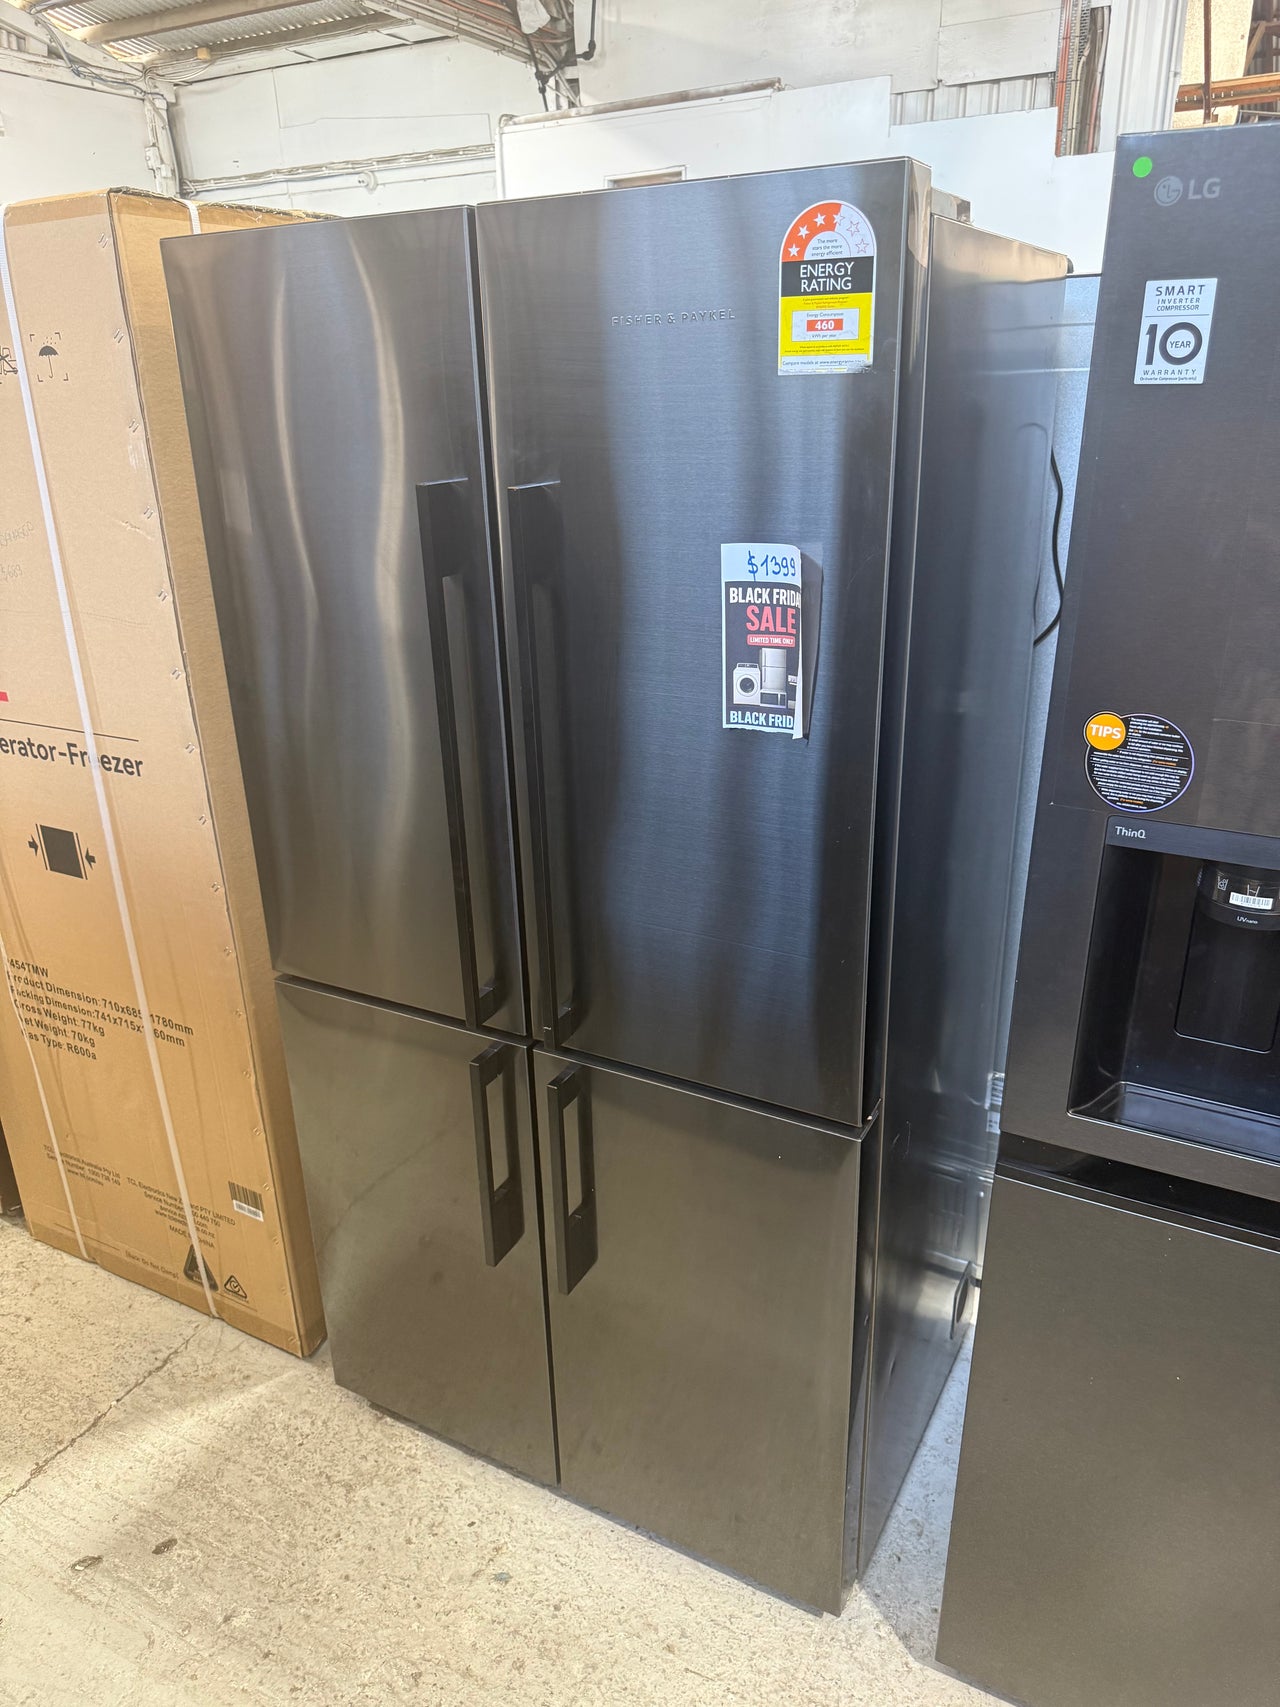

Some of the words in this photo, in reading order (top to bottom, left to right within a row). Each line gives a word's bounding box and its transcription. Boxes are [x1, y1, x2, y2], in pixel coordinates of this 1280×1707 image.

[1188, 177, 1221, 200] LG
[800, 261, 855, 278] ENERGY
[801, 277, 852, 293] RATING
[1155, 284, 1206, 297] SMART
[1156, 304, 1200, 312] COMPRESSOR
[1157, 297, 1201, 305] INVERTER
[611, 314, 662, 326] FISHER
[667, 312, 676, 324] &
[681, 308, 736, 322] PAYKEL
[814, 320, 835, 330] 460
[1145, 321, 1203, 366] 10
[1169, 340, 1192, 349] YEAR
[1143, 368, 1197, 376] WARRANTY
[747, 550, 797, 582] $1399
[729, 586, 771, 605] BLACK
[745, 604, 797, 635] SALE
[749, 636, 770, 644] LIMITED
[770, 637, 782, 645] TIME
[729, 710, 767, 726] BLACK
[1089, 723, 1122, 739] TIPS
[0, 737, 144, 777] erator-Frezer
[1115, 825, 1147, 839] ThinQ
[80, 1019, 105, 1038] 77kg
[71, 1030, 96, 1048] 70kg
[66, 1042, 97, 1060] R600a
